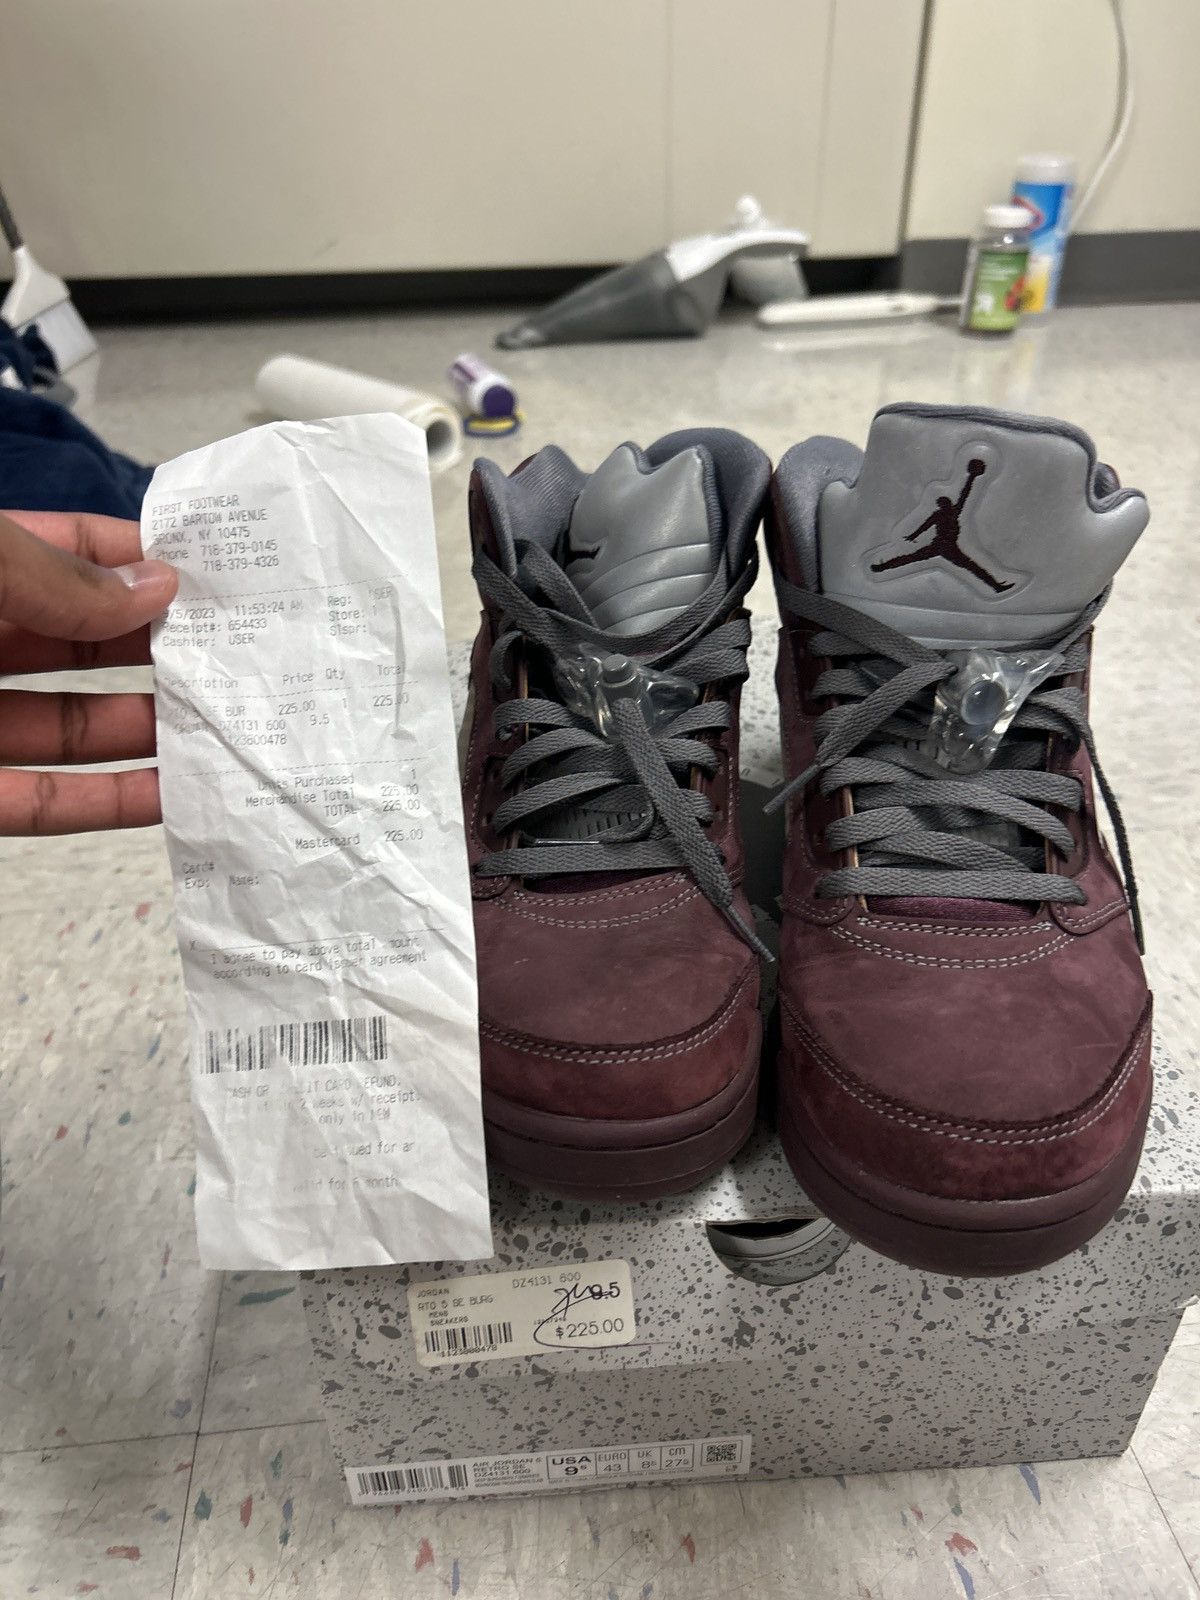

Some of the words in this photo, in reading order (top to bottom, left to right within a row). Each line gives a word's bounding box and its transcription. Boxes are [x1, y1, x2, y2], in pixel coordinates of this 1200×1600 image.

[152, 502, 182, 516] FIRST
[188, 495, 239, 510] FOOTWEAR
[152, 517, 177, 530] 2172
[182, 512, 222, 527] BARTOW
[229, 509, 268, 522] AVENUE
[198, 531, 210, 541] NY
[218, 526, 250, 538] 10475
[200, 539, 278, 557] 718-379-0145
[203, 555, 280, 572] 718-379-4326
[327, 595, 352, 606] Reg:
[234, 601, 285, 616] 11:53:24
[328, 609, 365, 622] Store:
[228, 618, 268, 631] 654433
[162, 636, 216, 648] Cashier:
[228, 633, 256, 645] USER
[164, 677, 239, 690] escription
[282, 673, 314, 686] Price
[325, 667, 346, 680] Qty
[278, 699, 316, 716] 225.00
[265, 720, 287, 731] 600
[309, 715, 330, 727] 9.5
[295, 774, 355, 788] Purchased
[323, 787, 355, 801] Total
[380, 784, 419, 797] 225.00
[295, 834, 361, 850] Mastercard
[384, 829, 424, 843] 225.00
[262, 950, 276, 961] to
[276, 964, 290, 975] to
[295, 959, 323, 972] card
[369, 950, 427, 967] agreement
[364, 1074, 401, 1088] EFUND,
[512, 1277, 553, 1290] DZ4131
[560, 1272, 582, 1283] 600
[555, 1317, 625, 1341] $225.00
[552, 1455, 592, 1466] USA
[598, 1451, 627, 1462] EURO
[637, 1449, 652, 1459] UK
[603, 1463, 622, 1473] 43
